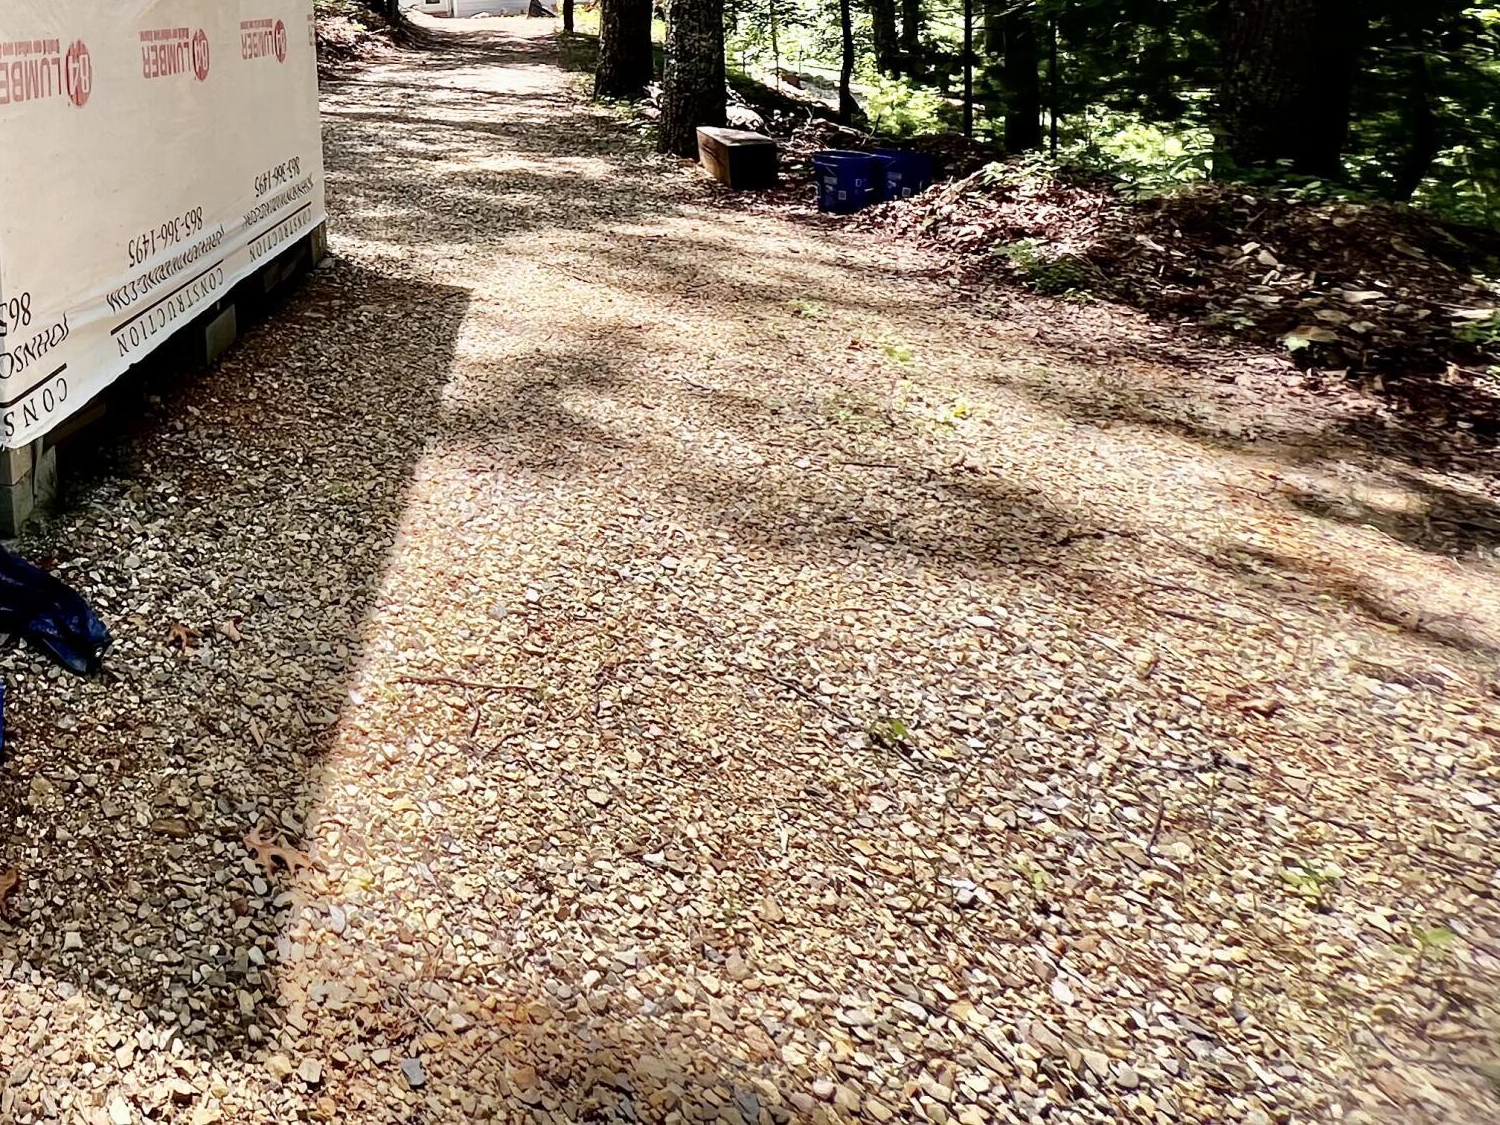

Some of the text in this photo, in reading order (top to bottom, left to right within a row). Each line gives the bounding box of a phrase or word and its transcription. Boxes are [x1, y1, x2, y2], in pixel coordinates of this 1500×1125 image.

[142, 42, 191, 79] LUMBER
[127, 206, 203, 267] 865-366-1495
[115, 268, 224, 358] CONSTRUCTION
